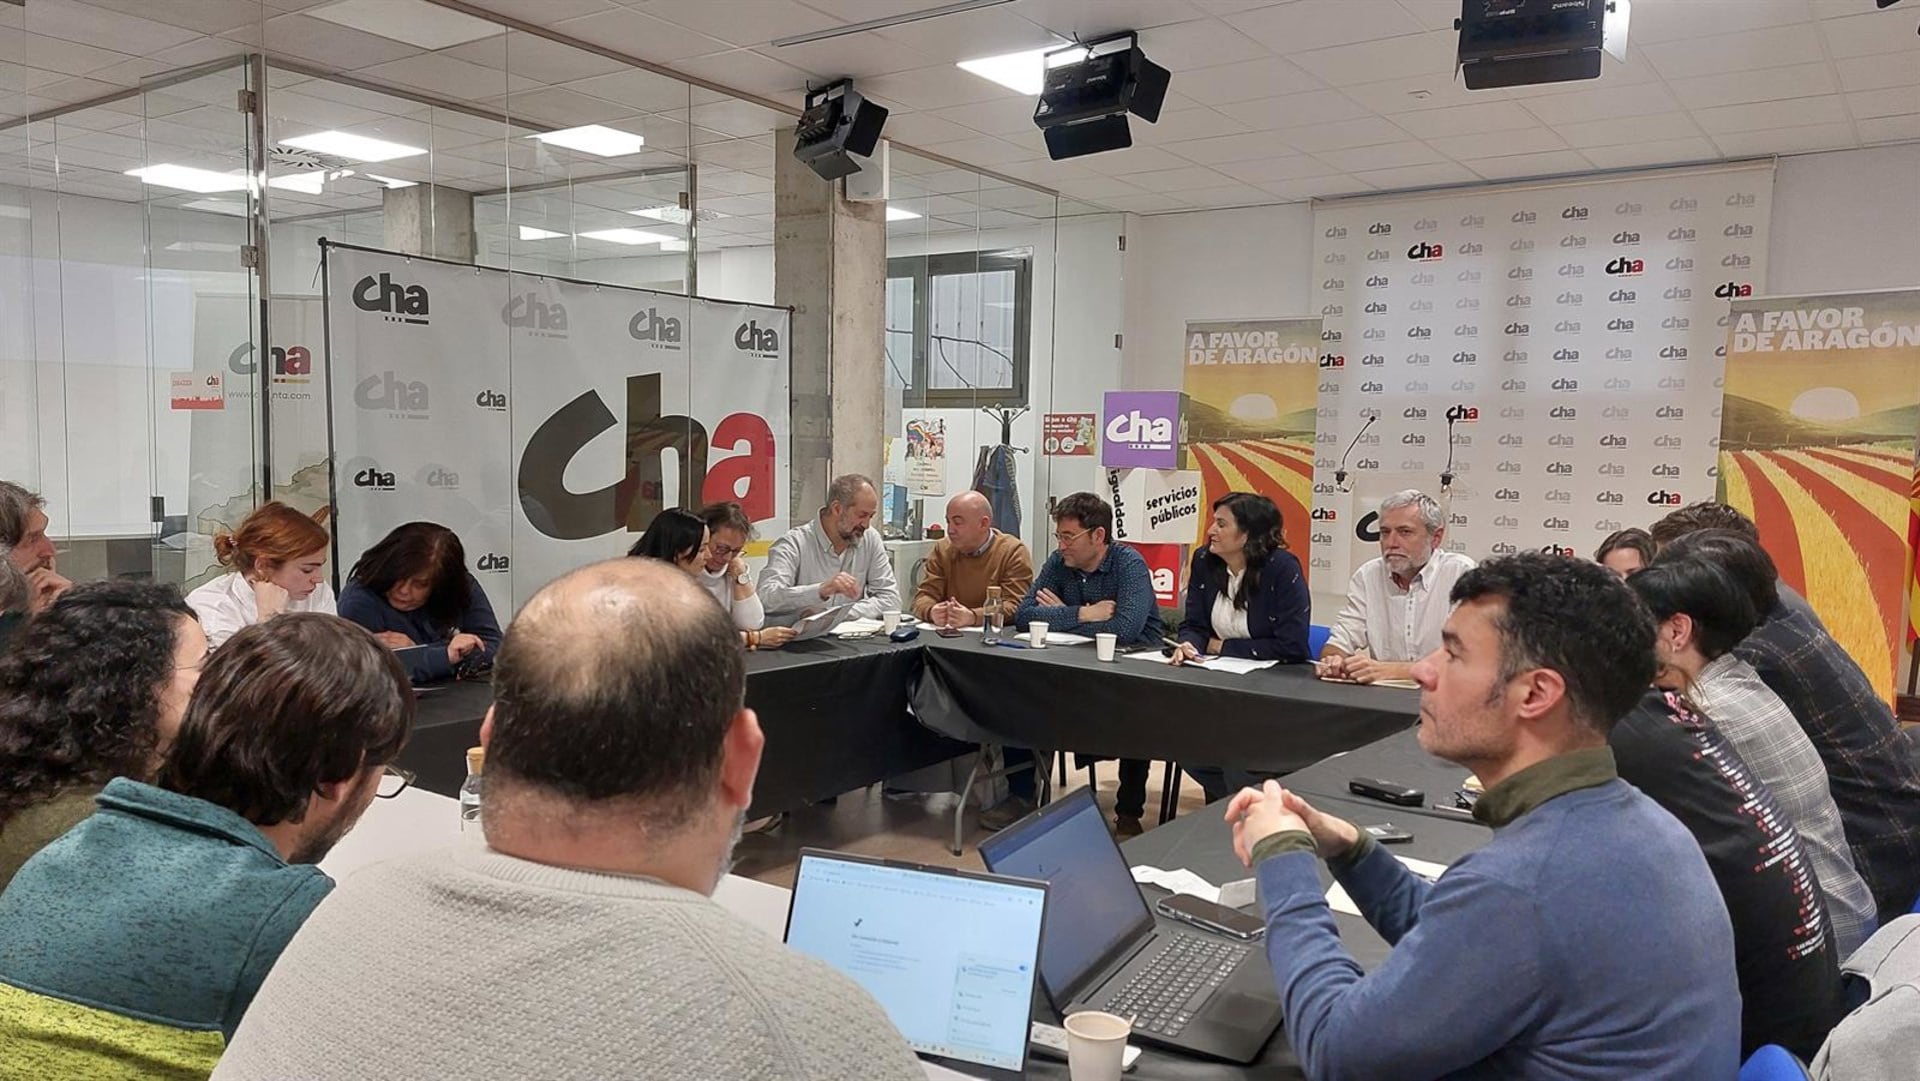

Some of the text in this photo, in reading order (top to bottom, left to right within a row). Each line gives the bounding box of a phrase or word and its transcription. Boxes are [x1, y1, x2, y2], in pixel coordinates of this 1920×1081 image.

[1669, 197, 1697, 209] cha
[1726, 193, 1755, 206] cha
[1562, 206, 1588, 218] cha
[1615, 202, 1642, 214] cha
[1460, 215, 1484, 226] cha
[1511, 211, 1536, 222] cha
[1369, 223, 1391, 234] cha
[1414, 218, 1437, 230] cha
[1724, 224, 1753, 236] cha
[1325, 227, 1347, 238] cha
[1613, 231, 1640, 243] cha
[1668, 227, 1696, 240] cha
[1510, 238, 1534, 251] cha
[1560, 235, 1586, 247] cha
[1408, 242, 1442, 259] cha
[1459, 242, 1482, 254] cha
[1367, 249, 1389, 260] cha
[1721, 254, 1751, 266] cha
[1606, 257, 1643, 274] cha
[1666, 257, 1694, 269] cha
[1508, 267, 1532, 279] cha
[1558, 264, 1584, 276] cha
[1323, 278, 1344, 289] cha
[1366, 276, 1388, 287] cha
[352, 273, 429, 316] cha
[1609, 290, 1635, 301] cha
[1664, 287, 1691, 299] cha
[1715, 282, 1751, 298] cha
[1506, 294, 1530, 306] cha
[1556, 292, 1582, 304] cha
[502, 293, 568, 331] cha
[1321, 304, 1343, 315] cha
[1365, 302, 1387, 313] cha
[628, 308, 681, 343] cha
[1555, 320, 1580, 332] cha
[1607, 319, 1633, 330] cha
[1662, 316, 1690, 328] cha
[1735, 313, 1757, 333] A
[1762, 307, 1864, 331] FAVOR
[1363, 328, 1385, 339] cha
[1408, 326, 1431, 337] cha
[1454, 324, 1477, 336] cha
[1504, 323, 1529, 334] cha
[735, 320, 778, 351] cha
[1190, 331, 1279, 348] A FAVOR
[1321, 330, 1341, 341] cha
[1734, 332, 1775, 353] DE
[1780, 321, 1920, 352] ARAGÓN
[1189, 343, 1317, 365] DE ARAGÓN
[1453, 352, 1476, 363] cha
[1503, 350, 1527, 361] cha
[1553, 349, 1579, 360] cha
[1605, 347, 1632, 359] cha
[1660, 346, 1687, 358] cha
[1319, 354, 1344, 368] cha
[1362, 354, 1384, 365] cha
[1406, 353, 1429, 364] cha
[1318, 382, 1339, 392] cha
[1361, 381, 1383, 392] cha
[1501, 379, 1525, 391] cha
[1552, 378, 1577, 389] cha
[353, 370, 429, 410] cha
[476, 390, 506, 407] cha
[1404, 407, 1426, 417] cha
[1446, 405, 1478, 419] cha
[1550, 406, 1575, 417] cha
[1656, 406, 1683, 417] cha
[1106, 410, 1172, 442] cha
[1317, 432, 1336, 443] cha
[1402, 433, 1425, 444] cha
[1498, 434, 1522, 445] cha
[1548, 434, 1574, 445] cha
[1600, 435, 1626, 446] cha
[1654, 435, 1681, 446] cha
[517, 372, 776, 541] cha
[1315, 458, 1335, 469] cha
[1357, 458, 1379, 469] cha
[1496, 461, 1521, 472] cha
[1547, 462, 1572, 473] cha
[1598, 463, 1624, 474] cha
[1652, 464, 1679, 475] cha
[354, 468, 395, 488] cha
[427, 469, 459, 486] cha
[1313, 483, 1334, 493] cha
[1495, 488, 1519, 499] cha
[1146, 486, 1197, 510] servicios
[1597, 491, 1623, 502] cha
[1647, 490, 1681, 504] cha
[1108, 468, 1127, 538] igualdad
[1150, 503, 1197, 530] públicos
[1312, 508, 1336, 520] cha
[1494, 515, 1518, 526] cha
[1543, 517, 1569, 528] cha
[1596, 520, 1621, 531] cha
[1311, 532, 1332, 543] cha
[1492, 542, 1517, 554] cha
[1541, 544, 1574, 558] cha
[477, 553, 509, 570] cha
